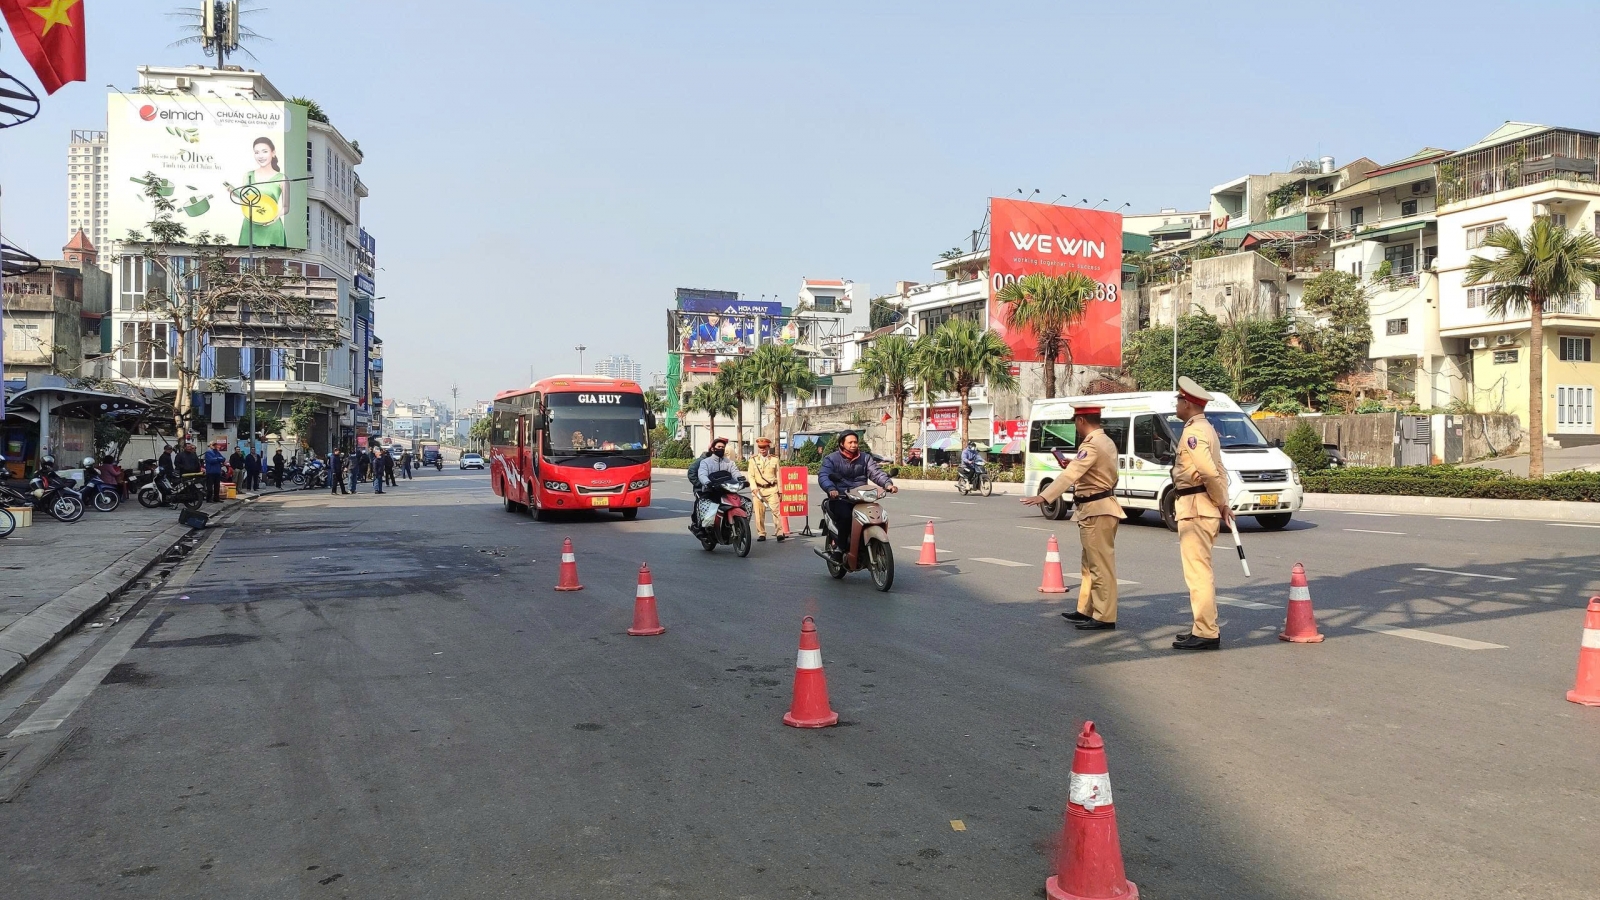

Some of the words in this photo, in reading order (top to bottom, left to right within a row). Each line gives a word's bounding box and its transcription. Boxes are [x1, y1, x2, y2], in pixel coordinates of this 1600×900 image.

[160, 109, 204, 121] elmich
[180, 150, 214, 163] Olive
[1009, 231, 1052, 254] WE
[1055, 236, 1105, 259] WIN
[578, 394, 597, 404] GIA
[598, 394, 622, 405] HUY
